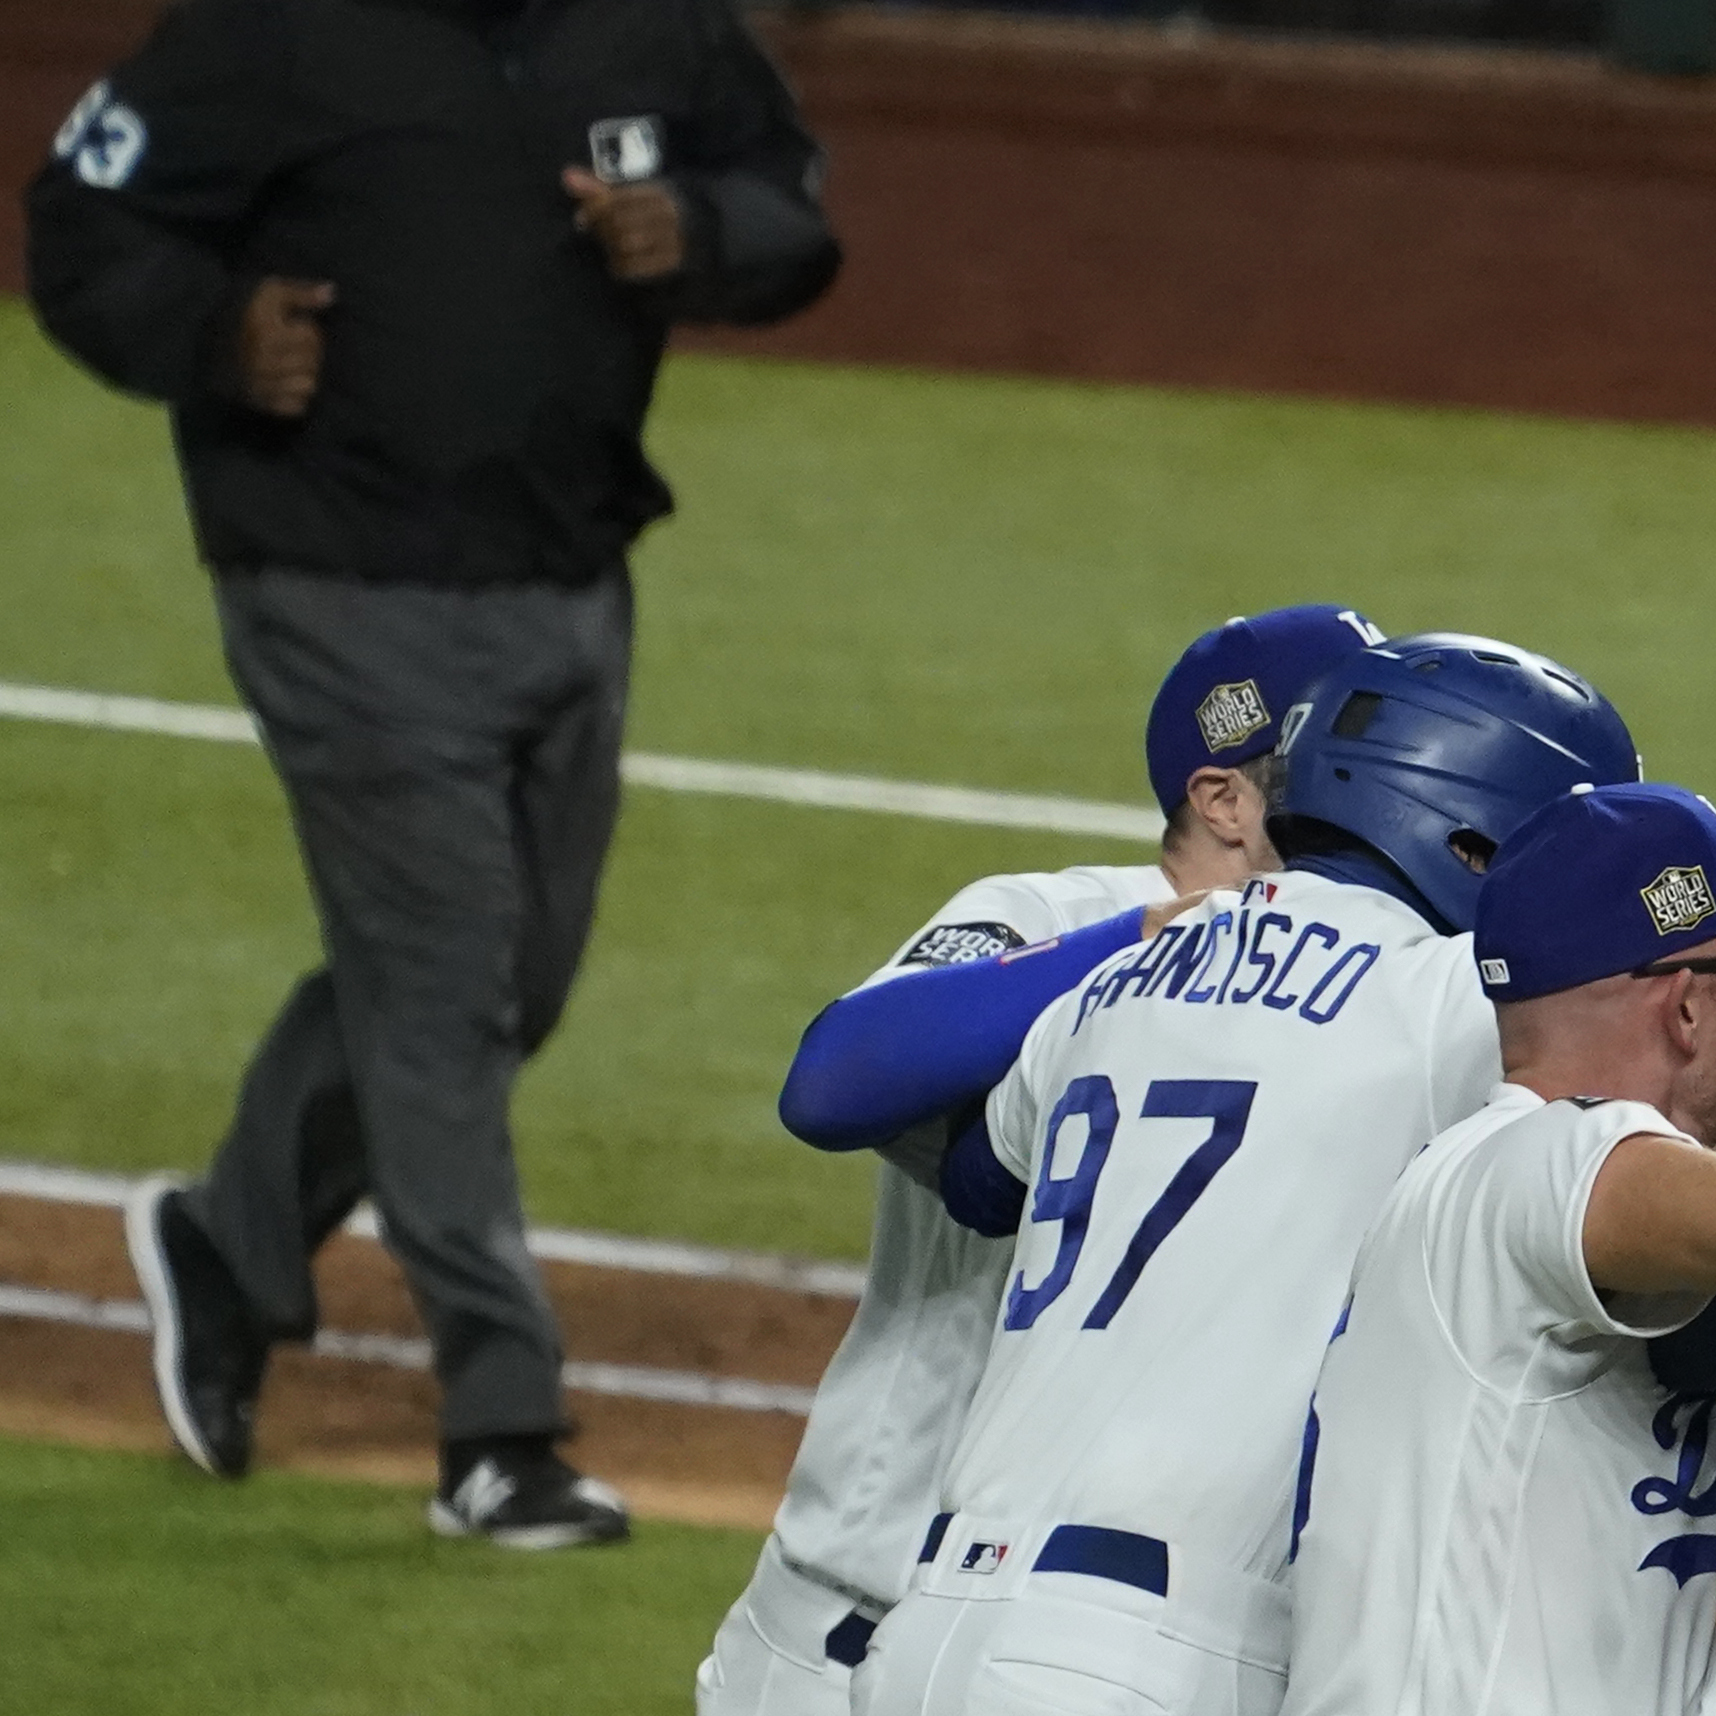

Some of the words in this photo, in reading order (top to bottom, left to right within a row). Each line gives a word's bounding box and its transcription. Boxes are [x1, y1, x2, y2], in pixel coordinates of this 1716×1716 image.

[1202, 686, 1254, 728] WORLD
[1206, 704, 1263, 746] SERIES
[1274, 703, 1314, 756] 97
[1647, 874, 1704, 909] WORLD
[1656, 889, 1711, 927] SERIES
[910, 940, 980, 963] SER
[931, 927, 1007, 957] WOR
[1004, 1074, 1259, 1331] 97
